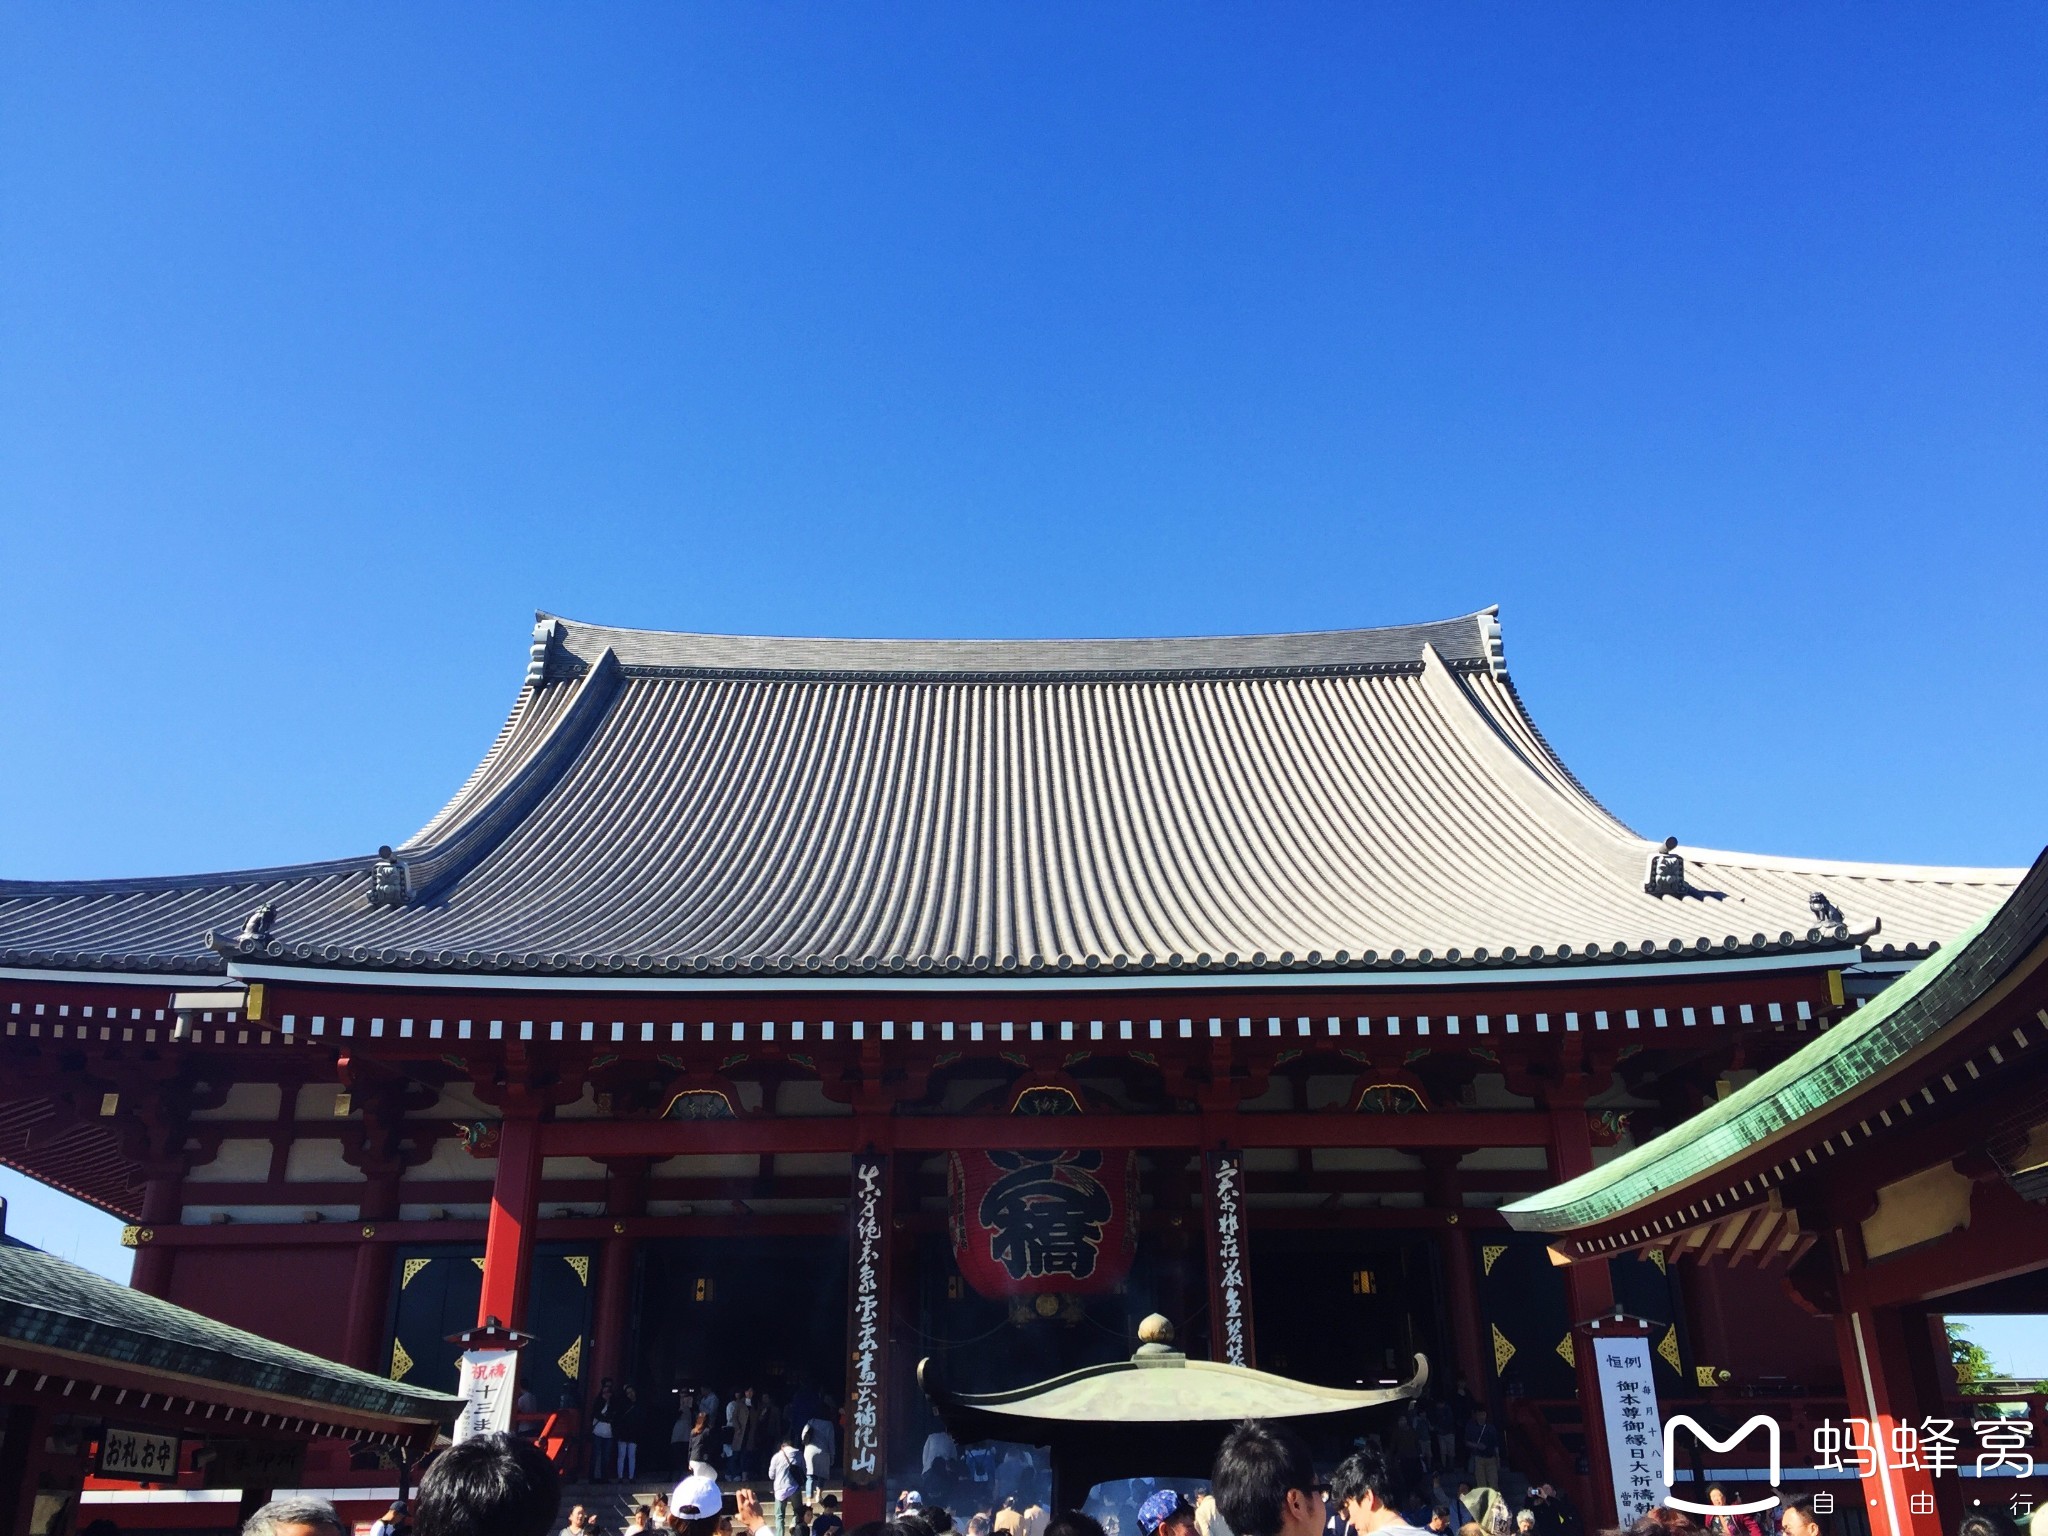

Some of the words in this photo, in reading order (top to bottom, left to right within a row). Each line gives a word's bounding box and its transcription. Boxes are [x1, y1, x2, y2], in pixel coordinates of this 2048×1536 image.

[1606, 1355, 1642, 1369] 恒例
[106, 1434, 171, 1472] お札お守
